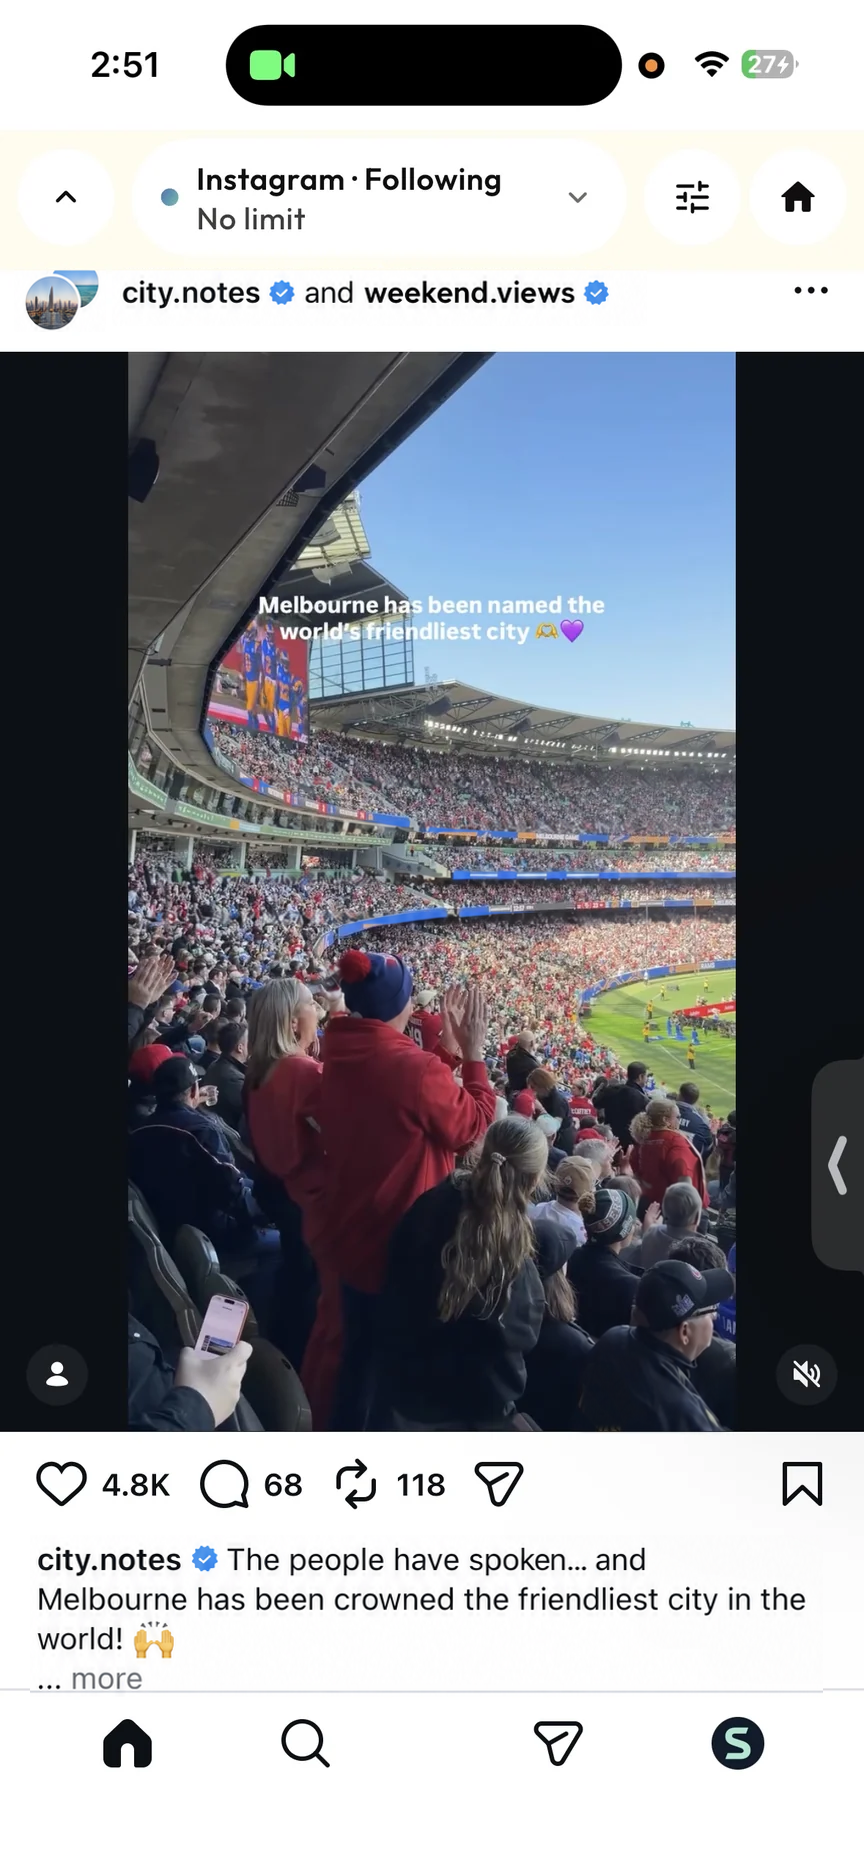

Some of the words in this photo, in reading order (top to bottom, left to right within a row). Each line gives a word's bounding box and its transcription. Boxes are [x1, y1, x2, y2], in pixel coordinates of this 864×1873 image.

[91, 50, 158, 79] 2:51
[748, 55, 777, 74] 27
[197, 167, 345, 198] Instagram
[365, 166, 501, 198] Following
[198, 207, 236, 231] No
[244, 206, 306, 231] limit
[122, 279, 261, 310] city.notes
[304, 280, 354, 304] and
[363, 279, 576, 304] weekend.views
[101, 1472, 171, 1497] 4.8K
[264, 1472, 303, 1497] 68
[397, 1472, 446, 1497] 118
[37, 1546, 182, 1577] city.notes
[226, 1547, 280, 1572] The
[289, 1546, 385, 1577] people
[394, 1547, 460, 1572] have
[595, 1546, 646, 1572] and
[38, 1586, 188, 1611] Melbourne
[197, 1586, 246, 1611] has
[255, 1586, 324, 1611] been
[334, 1586, 454, 1611] crowned
[463, 1586, 510, 1611] the
[517, 1586, 659, 1611] friendliest
[668, 1586, 719, 1617] city
[728, 1586, 751, 1611] in
[760, 1586, 806, 1611] the
[37, 1626, 123, 1651] world!
[72, 1671, 143, 1690] more
